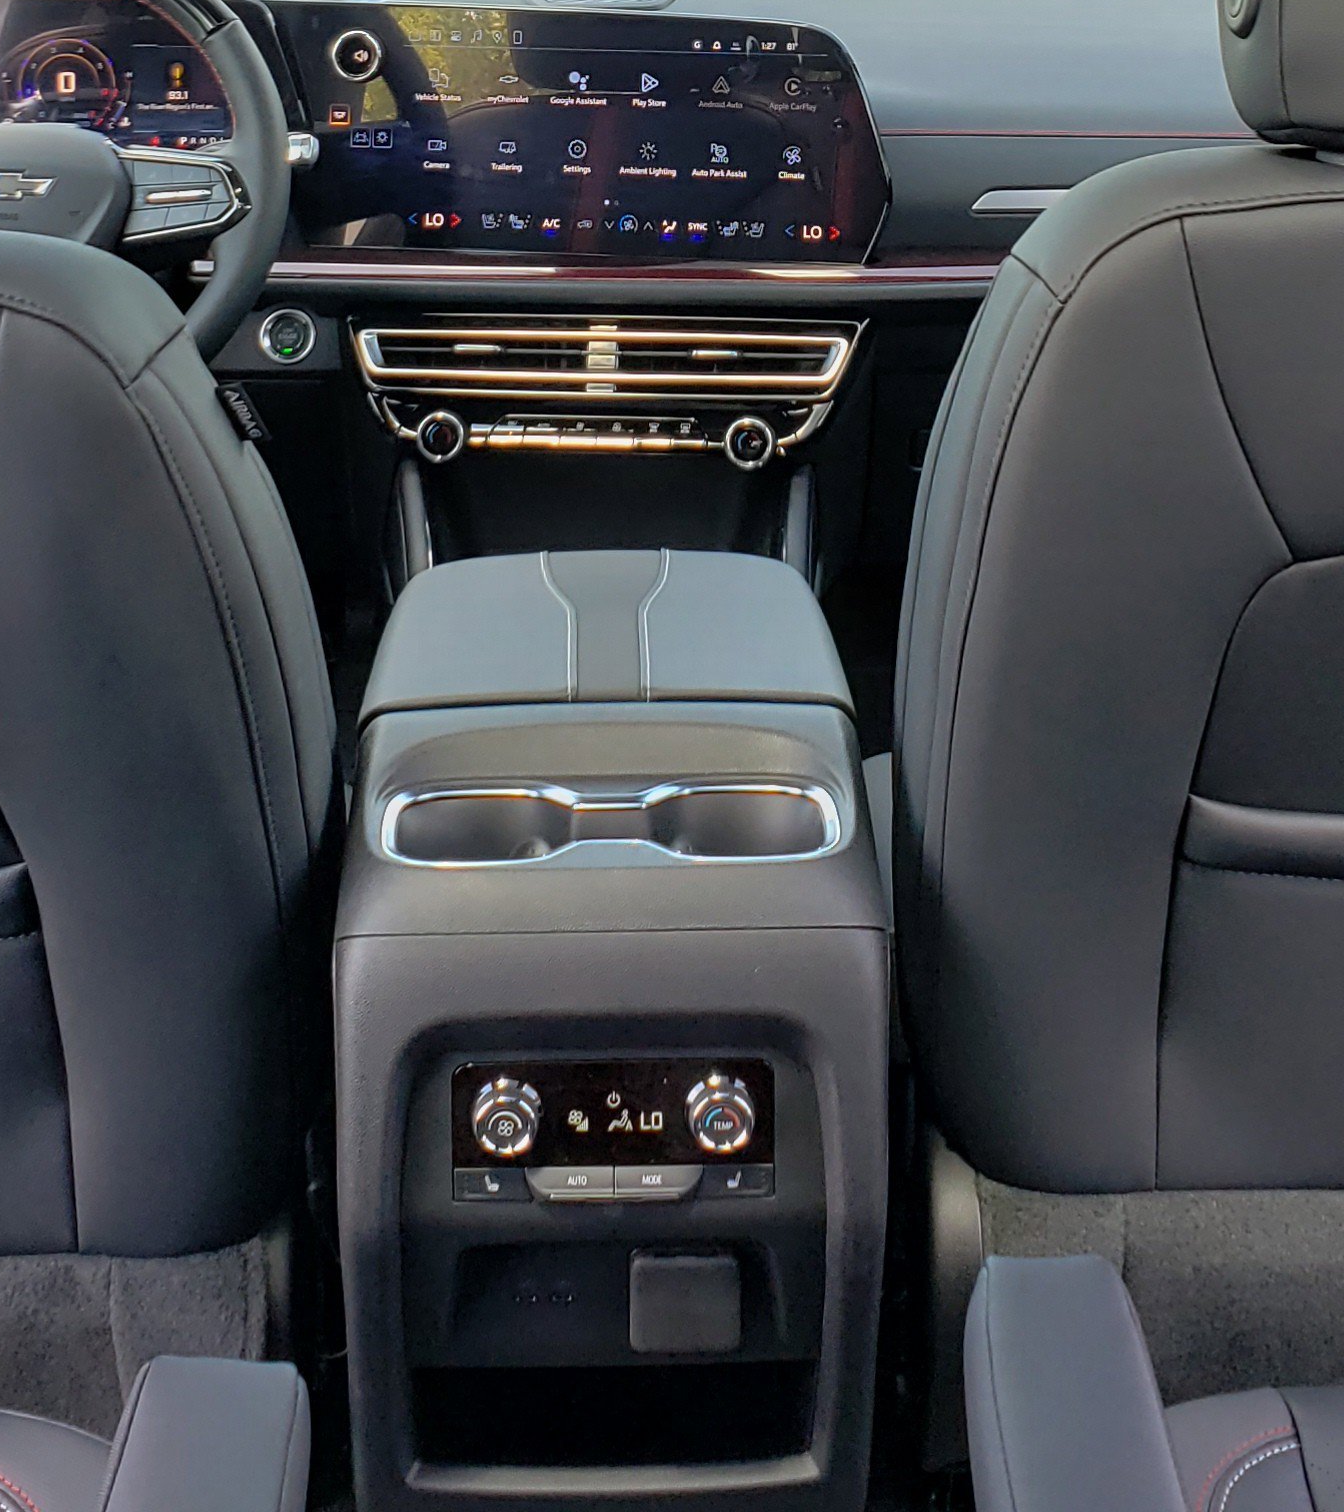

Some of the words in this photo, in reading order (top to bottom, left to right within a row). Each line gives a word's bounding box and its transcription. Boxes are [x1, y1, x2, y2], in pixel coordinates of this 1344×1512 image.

[761, 42, 776, 50] 1:27
[168, 90, 189, 100] 93.1
[415, 93, 439, 102] Vehicle
[440, 93, 462, 102] Status
[487, 95, 529, 104] myChevrolet
[550, 96, 574, 106] Google
[575, 97, 607, 105] Assistant
[632, 98, 647, 108] Play
[648, 99, 667, 108] Store
[699, 100, 726, 109] Android
[726, 101, 743, 109] Auto
[768, 102, 789, 111] Apple
[790, 103, 817, 113] CarPlay
[423, 161, 451, 170] Camera
[491, 162, 523, 173] Trailering
[563, 165, 591, 175] Settings
[619, 166, 648, 175] Ambient
[648, 167, 677, 177] Lighting
[691, 169, 708, 177] Auto
[709, 169, 725, 177] Park
[725, 169, 747, 178] Assist
[778, 171, 805, 180] Climate
[425, 213, 444, 227] LO
[543, 218, 561, 228] A/C
[688, 222, 708, 231] SYNC
[803, 225, 822, 238] LO
[639, 1111, 662, 1130] LO
[713, 1120, 733, 1130] TEMP
[567, 1175, 587, 1185] AUTO
[641, 1174, 662, 1185] MODE
